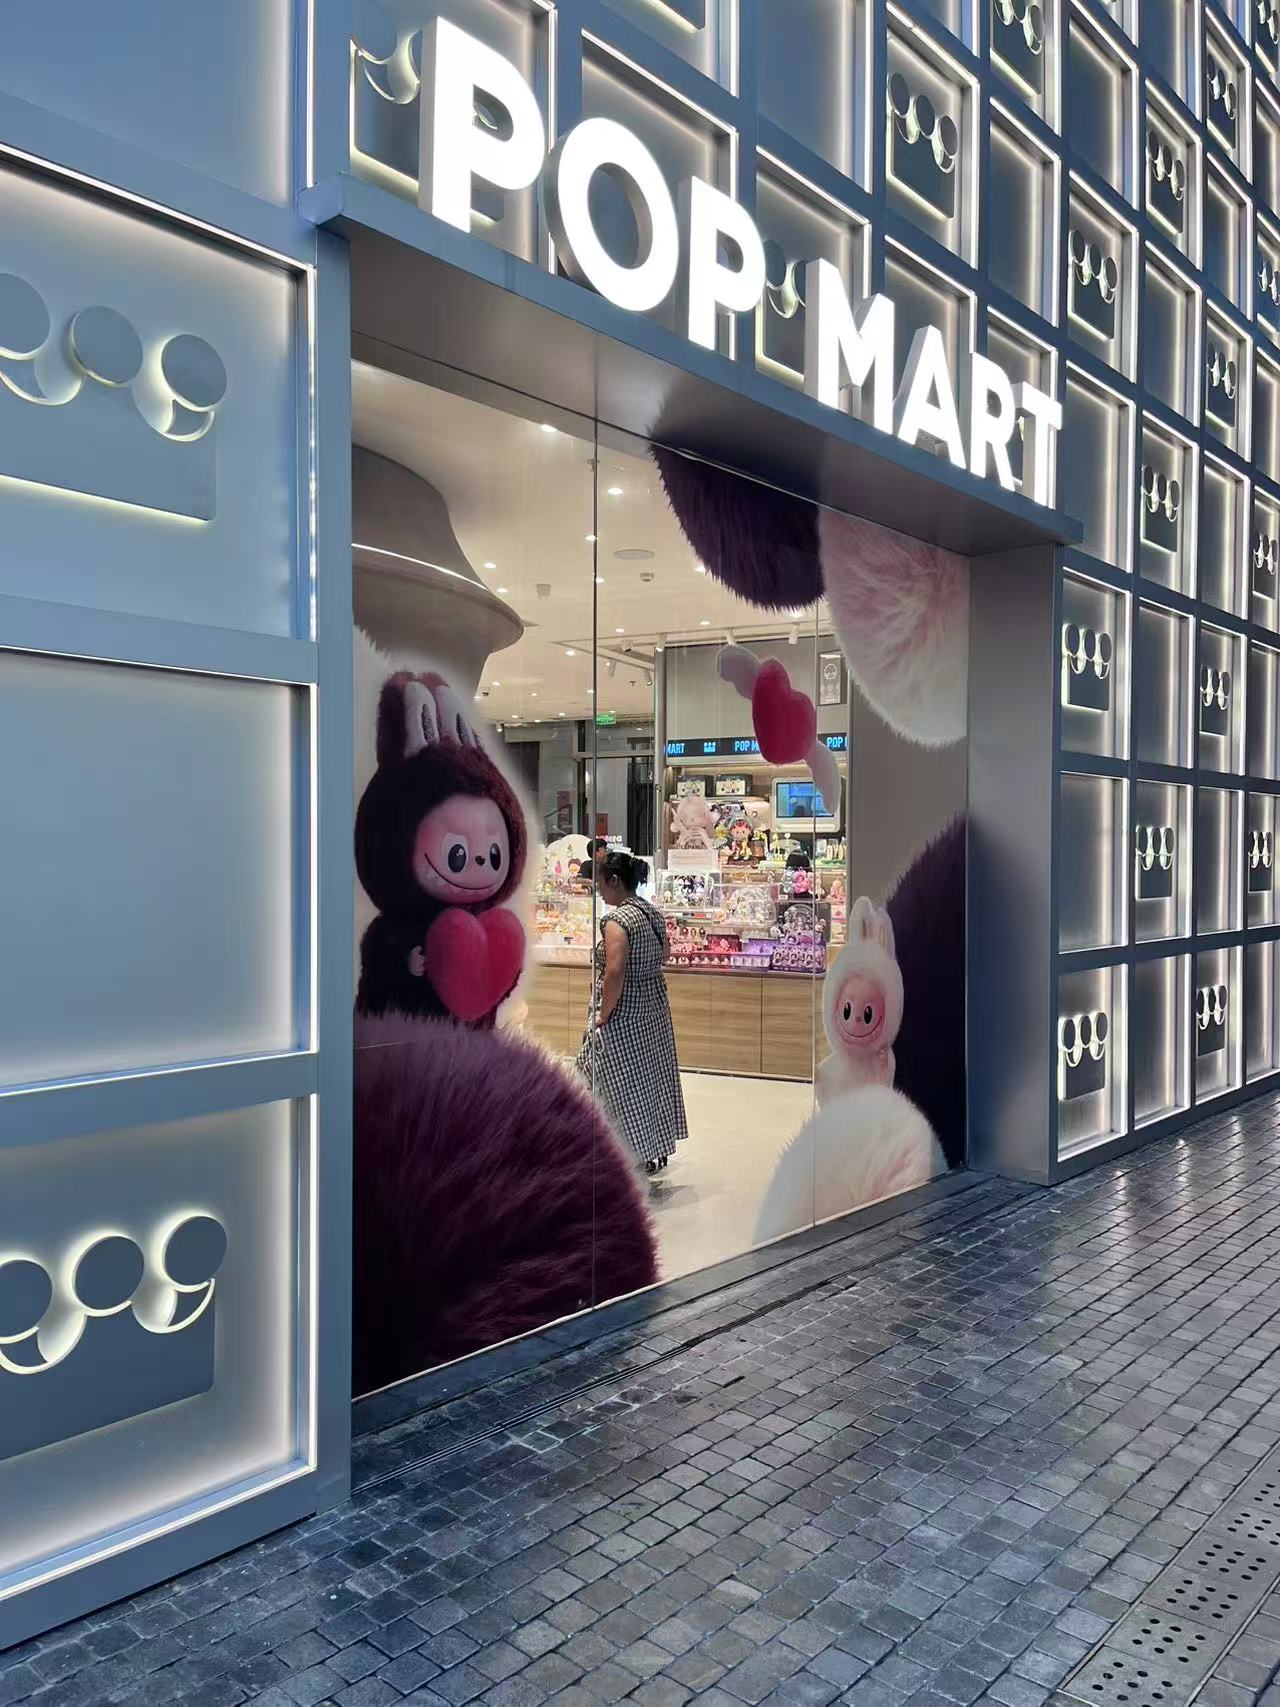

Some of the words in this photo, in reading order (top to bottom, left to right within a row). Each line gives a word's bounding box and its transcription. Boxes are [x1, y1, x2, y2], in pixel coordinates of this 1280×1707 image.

[430, 16, 766, 351] POP
[816, 258, 1063, 509] MART
[734, 740, 750, 752] POP
[826, 736, 844, 748] POP
